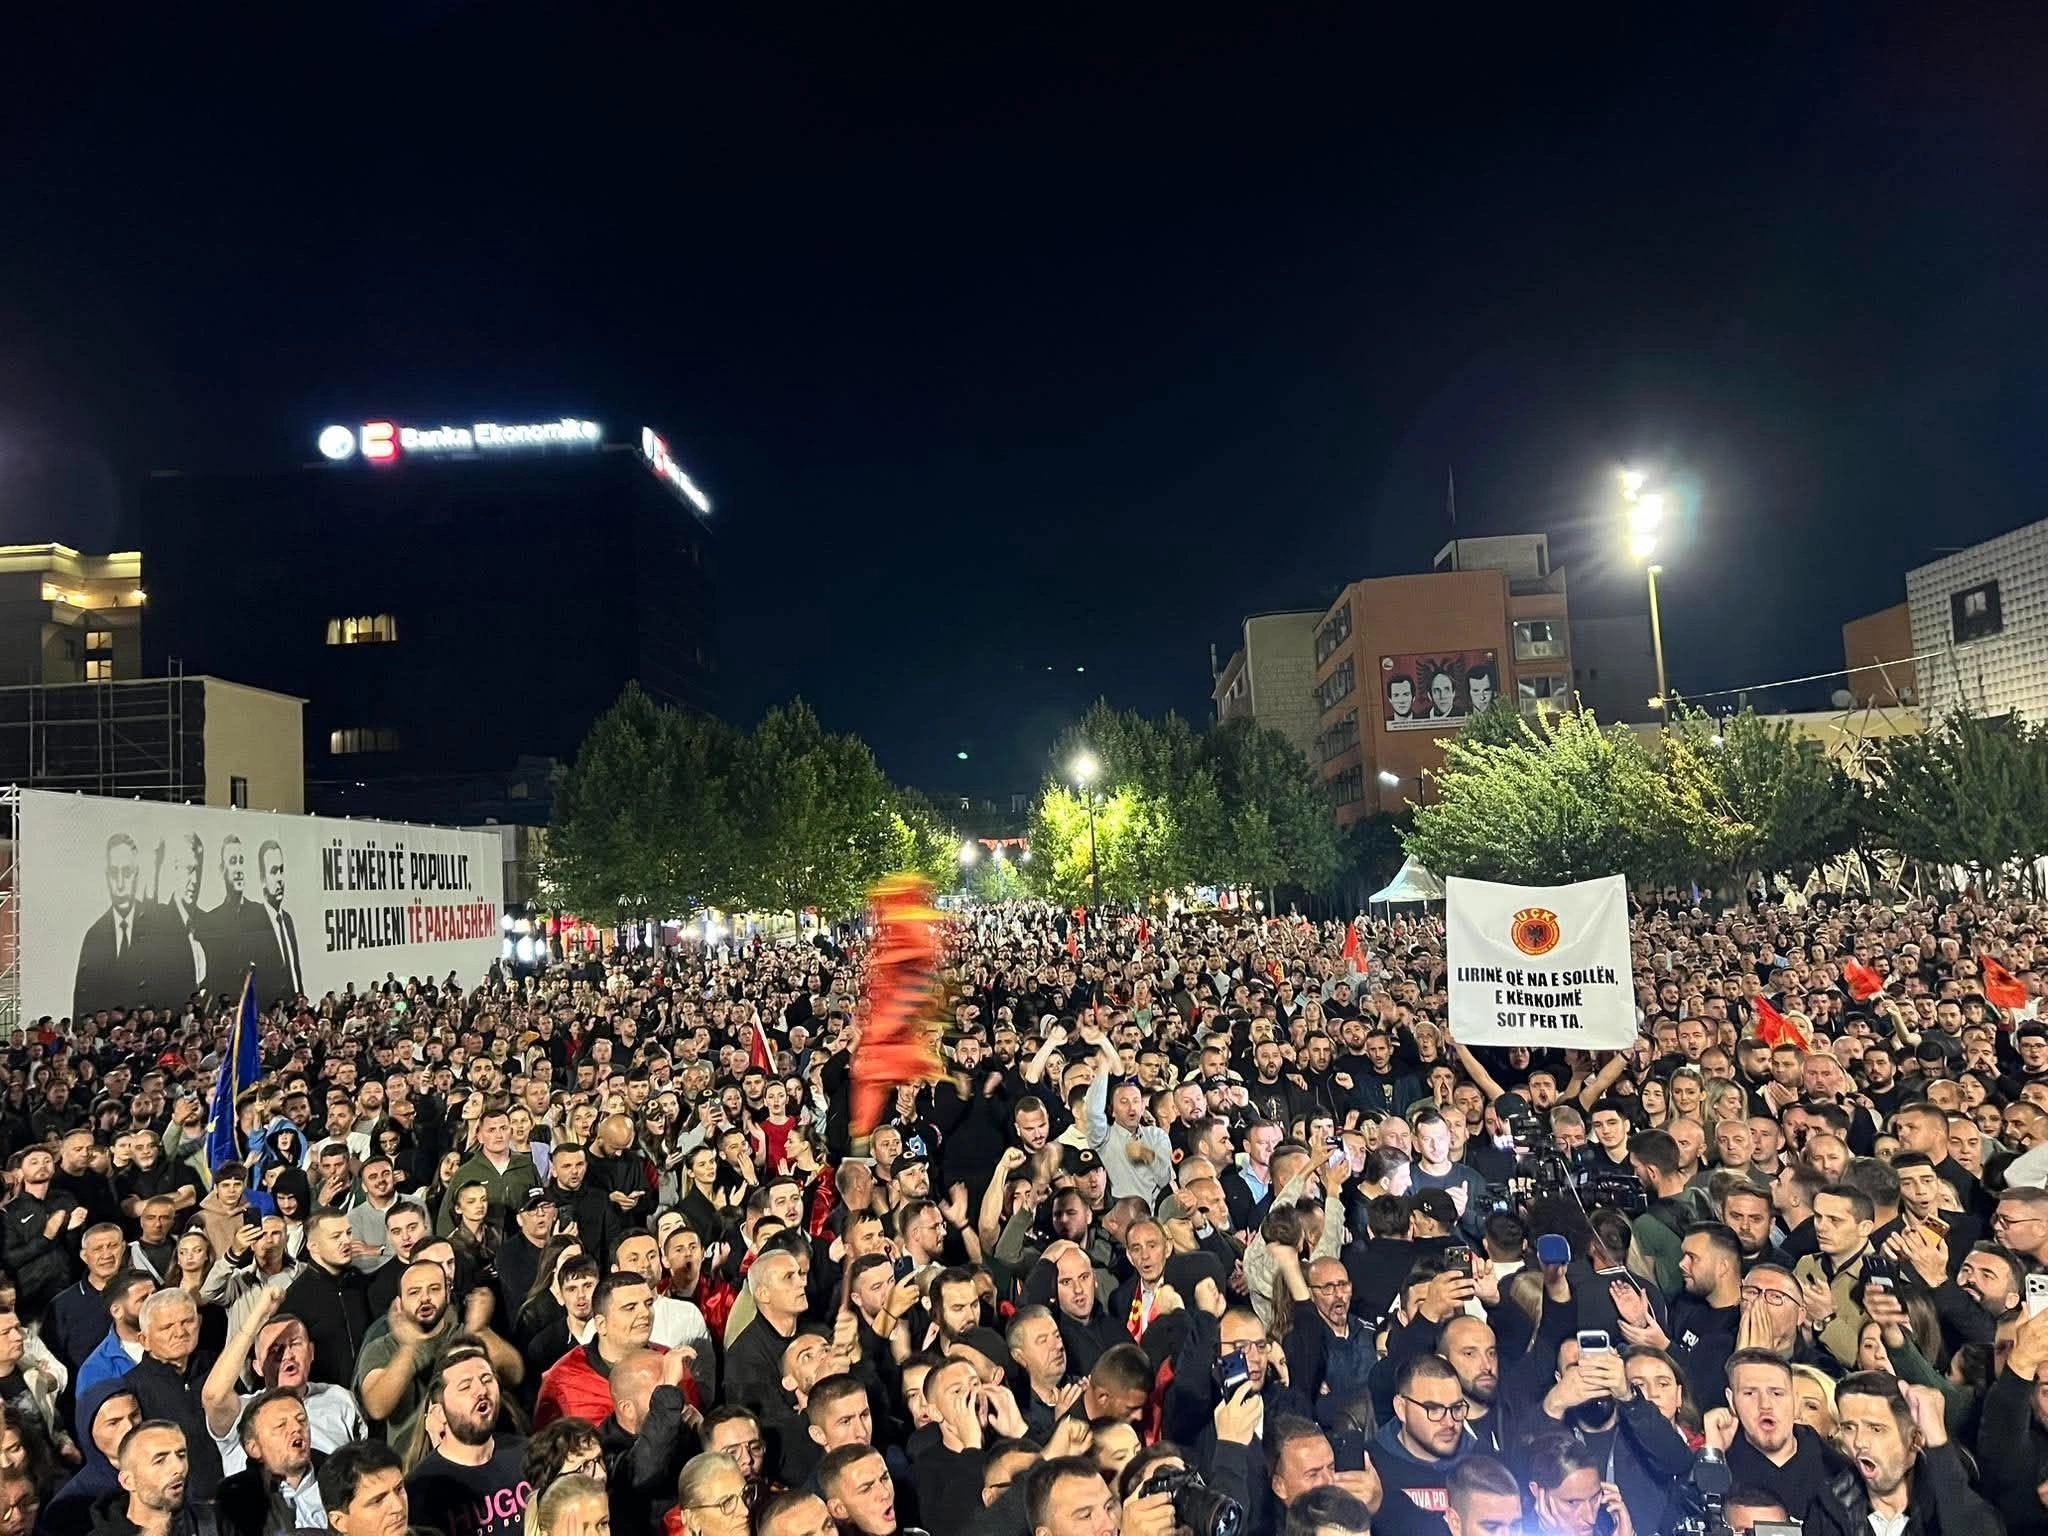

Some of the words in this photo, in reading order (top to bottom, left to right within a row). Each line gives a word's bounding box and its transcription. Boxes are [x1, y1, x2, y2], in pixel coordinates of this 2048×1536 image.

[400, 425, 472, 448] Banka
[322, 838, 343, 891] NË
[347, 841, 386, 891] EMËR
[388, 842, 405, 890] TË
[410, 852, 472, 892] POPULLIT,
[324, 906, 405, 952] SHPALLENI
[407, 897, 423, 944] TË
[425, 896, 496, 943] PAFAJSHËM!
[1516, 909, 1554, 922] UÇK
[1457, 967, 1503, 983] LIRINË
[1506, 968, 1525, 987] QË
[1527, 974, 1548, 987] NA
[1551, 972, 1559, 986] E
[1563, 965, 1619, 985] SOLLËN,
[1495, 990, 1503, 1004] E
[1506, 988, 1583, 1008] KËRKOJMË
[1497, 1012, 1526, 1027] SOT
[1530, 1013, 1557, 1029] PER
[1560, 1014, 1583, 1029] TA.
